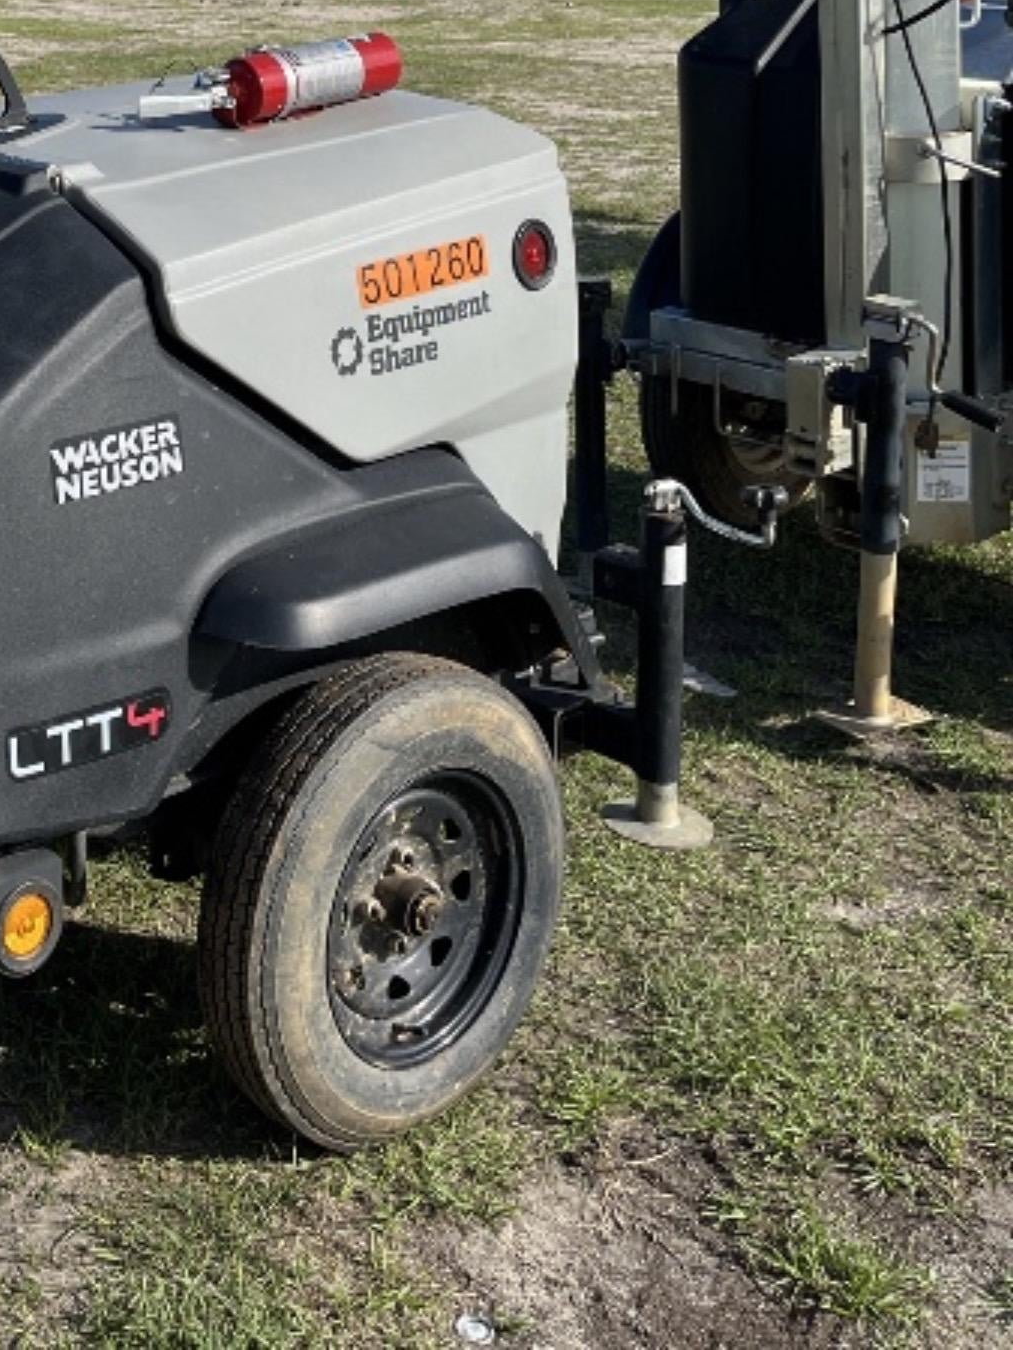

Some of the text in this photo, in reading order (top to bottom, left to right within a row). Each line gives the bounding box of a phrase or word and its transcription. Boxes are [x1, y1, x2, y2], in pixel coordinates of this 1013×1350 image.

[360, 237, 484, 304] 501260
[365, 290, 492, 343] Equipment
[368, 340, 439, 376] Share
[48, 419, 181, 476] WACKER
[54, 445, 184, 505] NEUSON
[8, 698, 166, 778] LTT4
